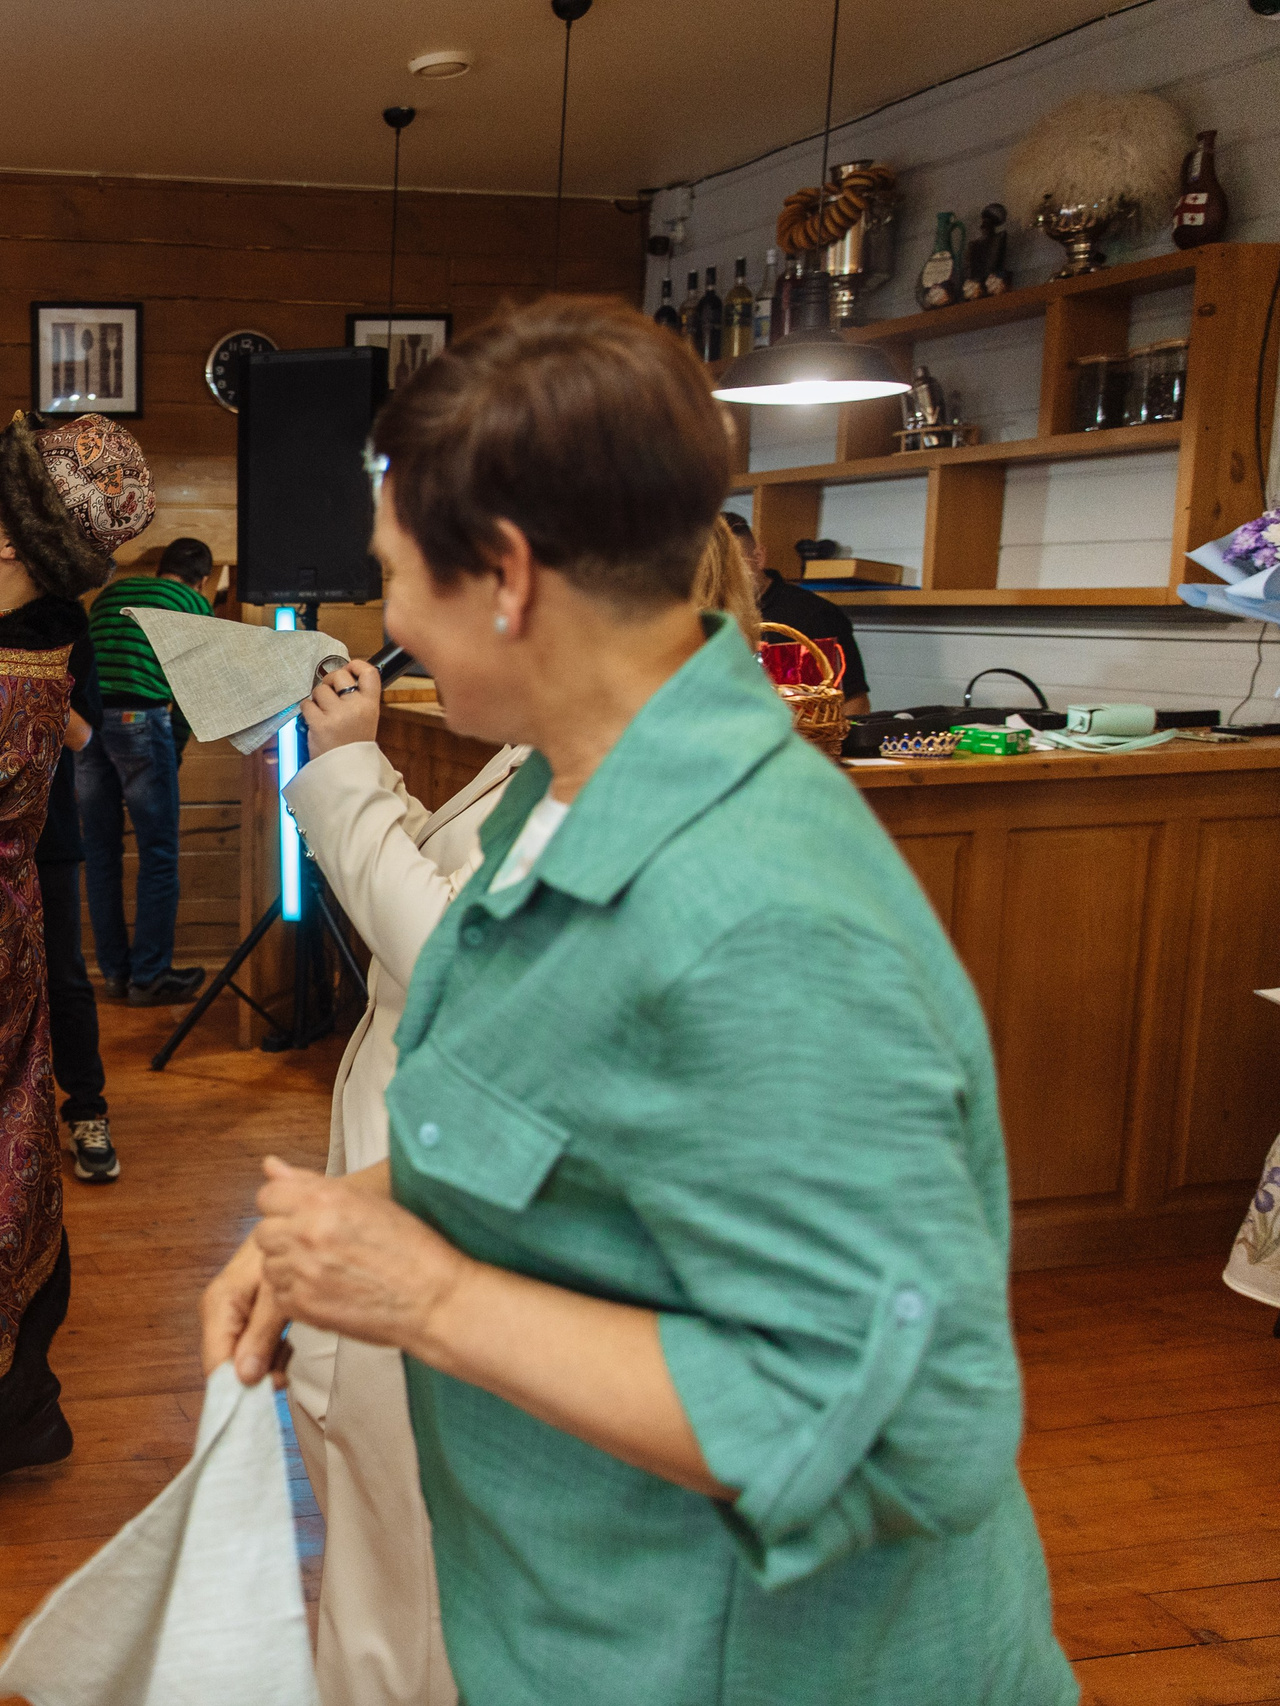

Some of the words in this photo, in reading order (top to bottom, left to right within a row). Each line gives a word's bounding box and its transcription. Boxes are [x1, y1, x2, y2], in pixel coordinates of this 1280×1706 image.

[215, 365, 225, 376] 9
[217, 379, 227, 390] 8
[227, 390, 236, 401] 7
